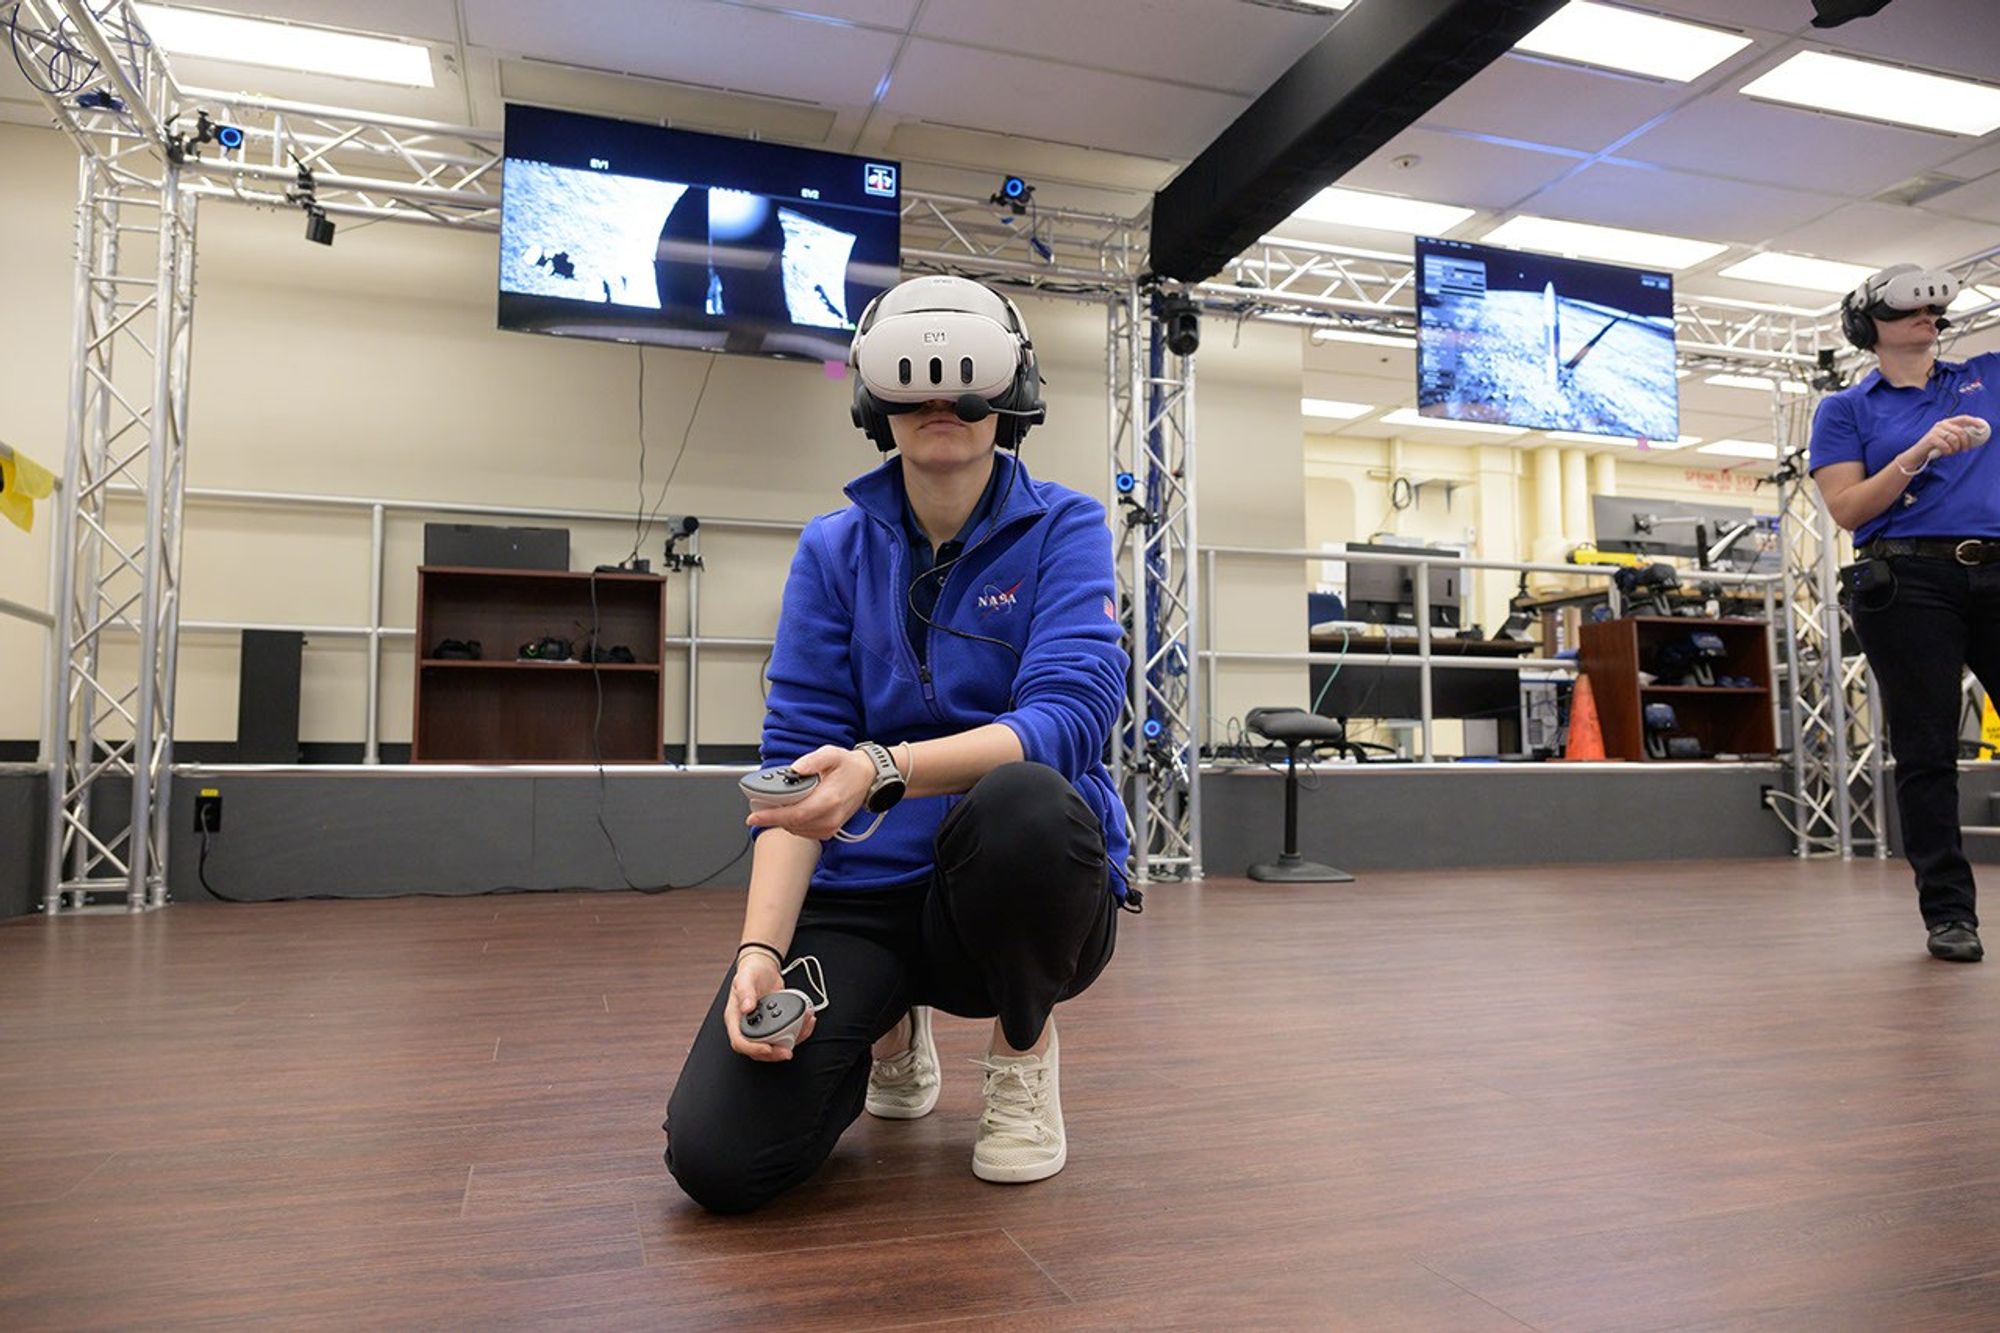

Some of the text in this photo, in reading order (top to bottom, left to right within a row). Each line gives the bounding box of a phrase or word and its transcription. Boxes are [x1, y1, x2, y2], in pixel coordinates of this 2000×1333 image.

[590, 158, 609, 170] EV1
[924, 332, 945, 343] EV1
[978, 593, 1017, 607] NASA
